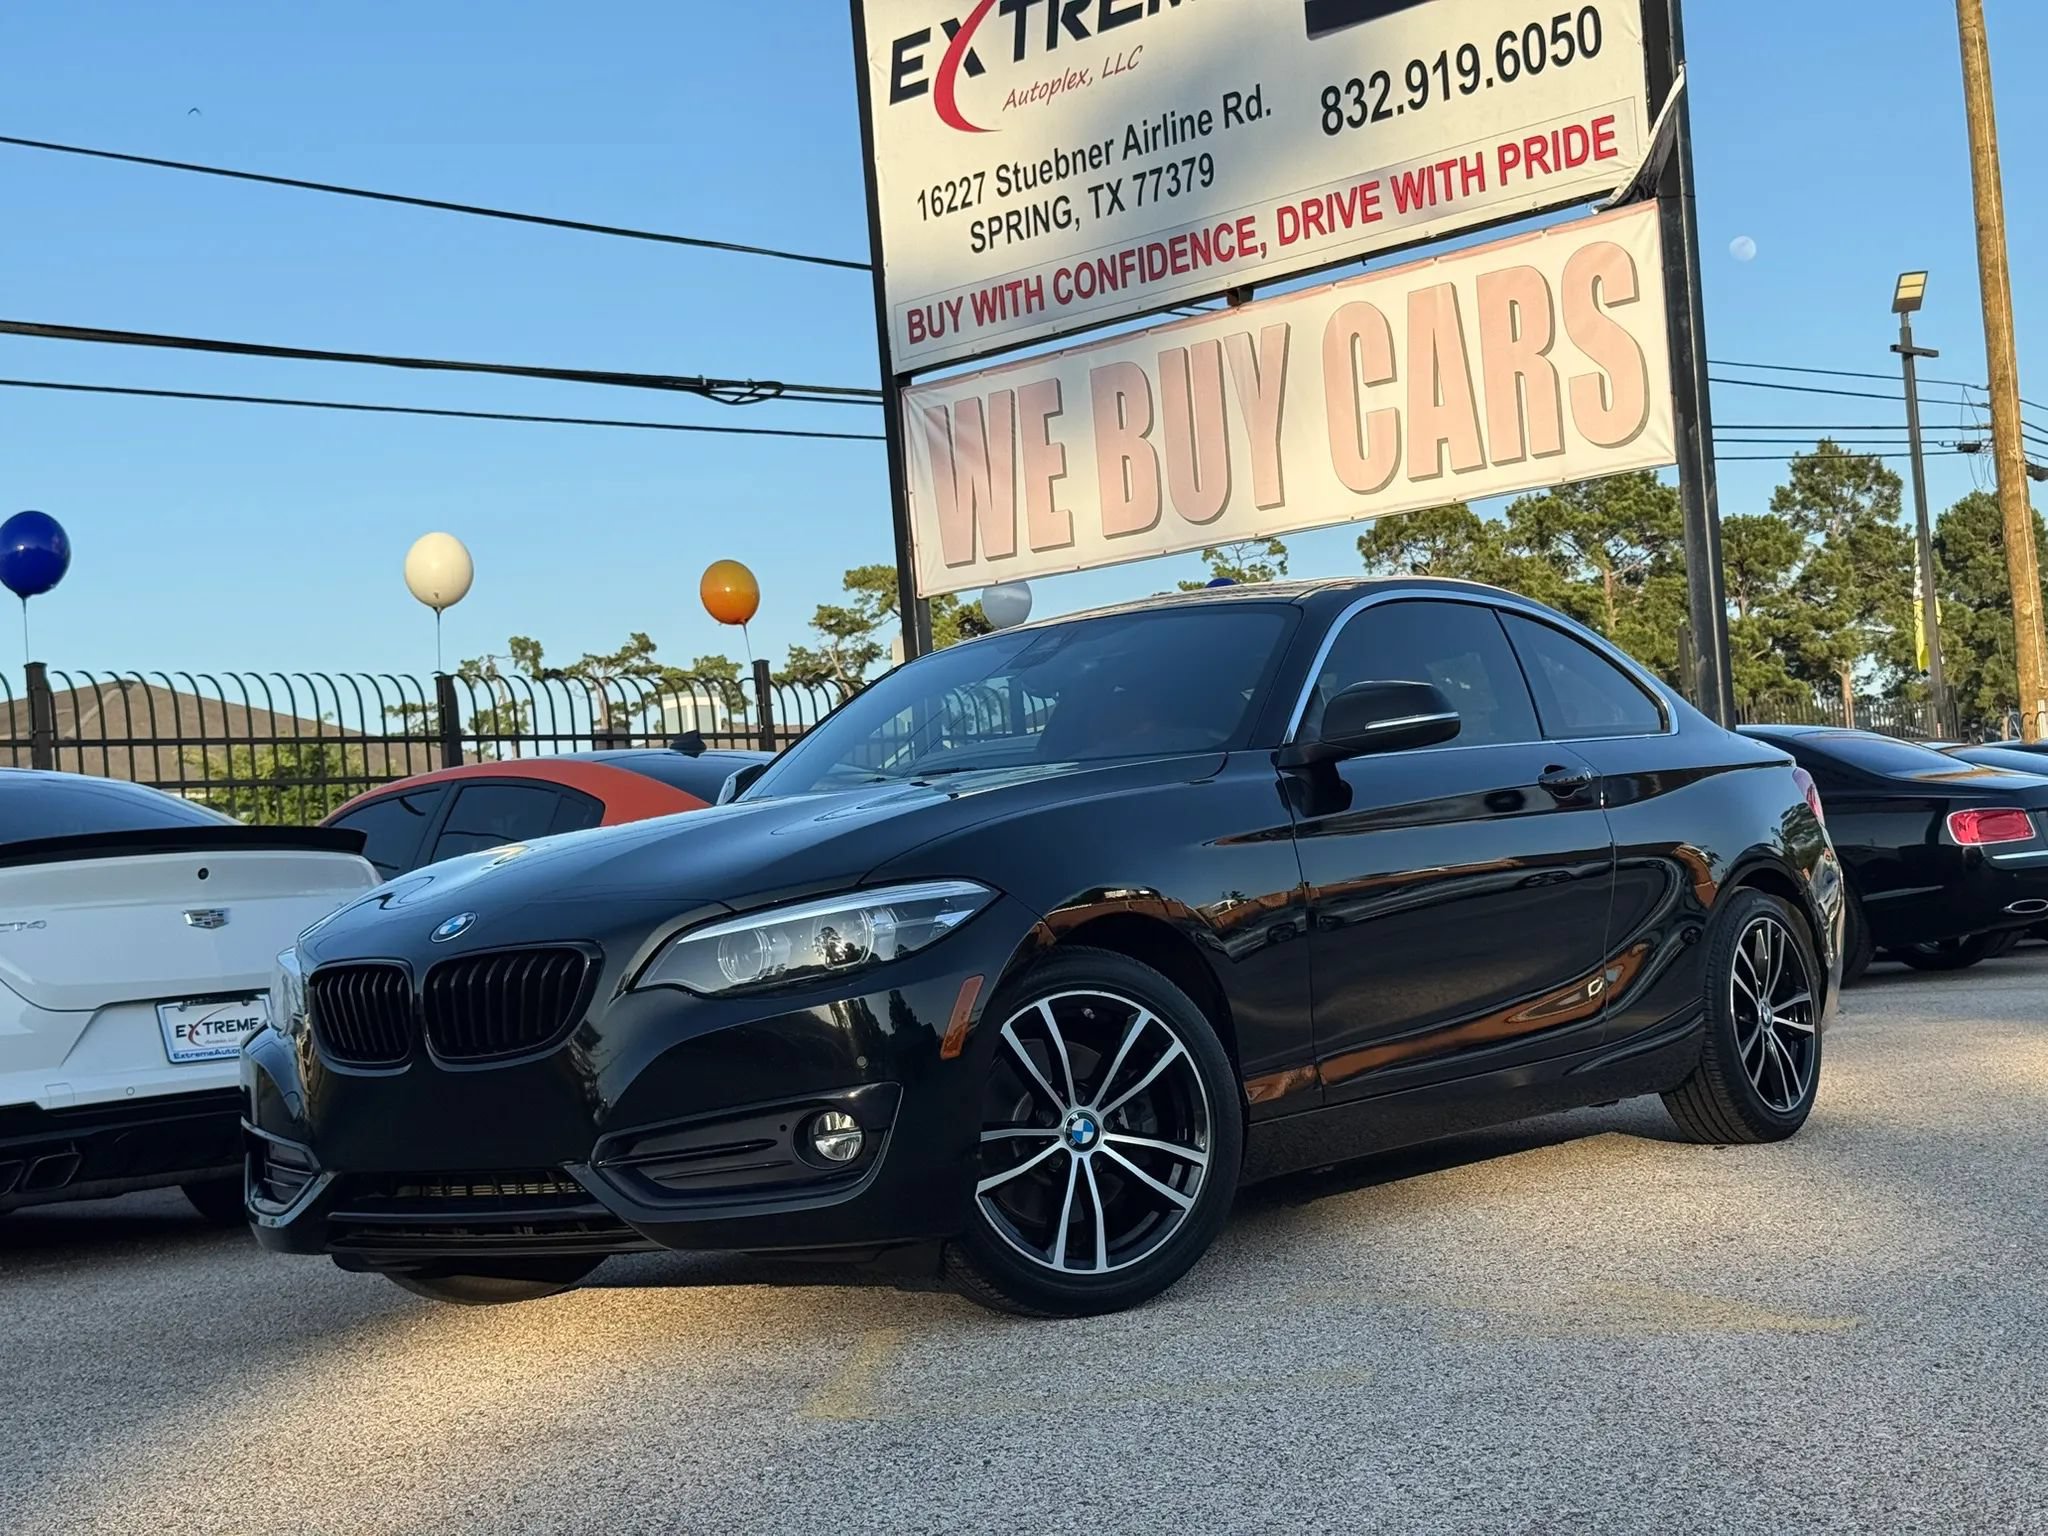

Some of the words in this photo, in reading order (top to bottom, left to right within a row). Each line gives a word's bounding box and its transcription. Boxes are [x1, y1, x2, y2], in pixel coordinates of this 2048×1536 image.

[1002, 66, 1093, 111] Autoplex,
[1102, 45, 1143, 79] LLC
[1321, 5, 1602, 135] 832.919.6050
[917, 171, 986, 221] 16227
[996, 138, 1114, 197] Stuebner
[1122, 106, 1213, 160] Airline
[1223, 84, 1272, 129] Rd.
[970, 194, 1080, 253] SPRING,
[1088, 178, 1125, 219] TX
[1132, 153, 1214, 207] 77379
[907, 296, 964, 344] BUY
[970, 275, 1044, 327] WITH
[1053, 216, 1267, 305] CONFIDENCE,
[1277, 180, 1383, 246] DRIVE
[1390, 152, 1486, 214] WITH
[1498, 115, 1618, 186] PRIDE
[928, 377, 1074, 568] WE
[1090, 322, 1290, 539] BUY
[1322, 241, 1649, 494] CARS
[175, 1012, 260, 1044] EXTREME
